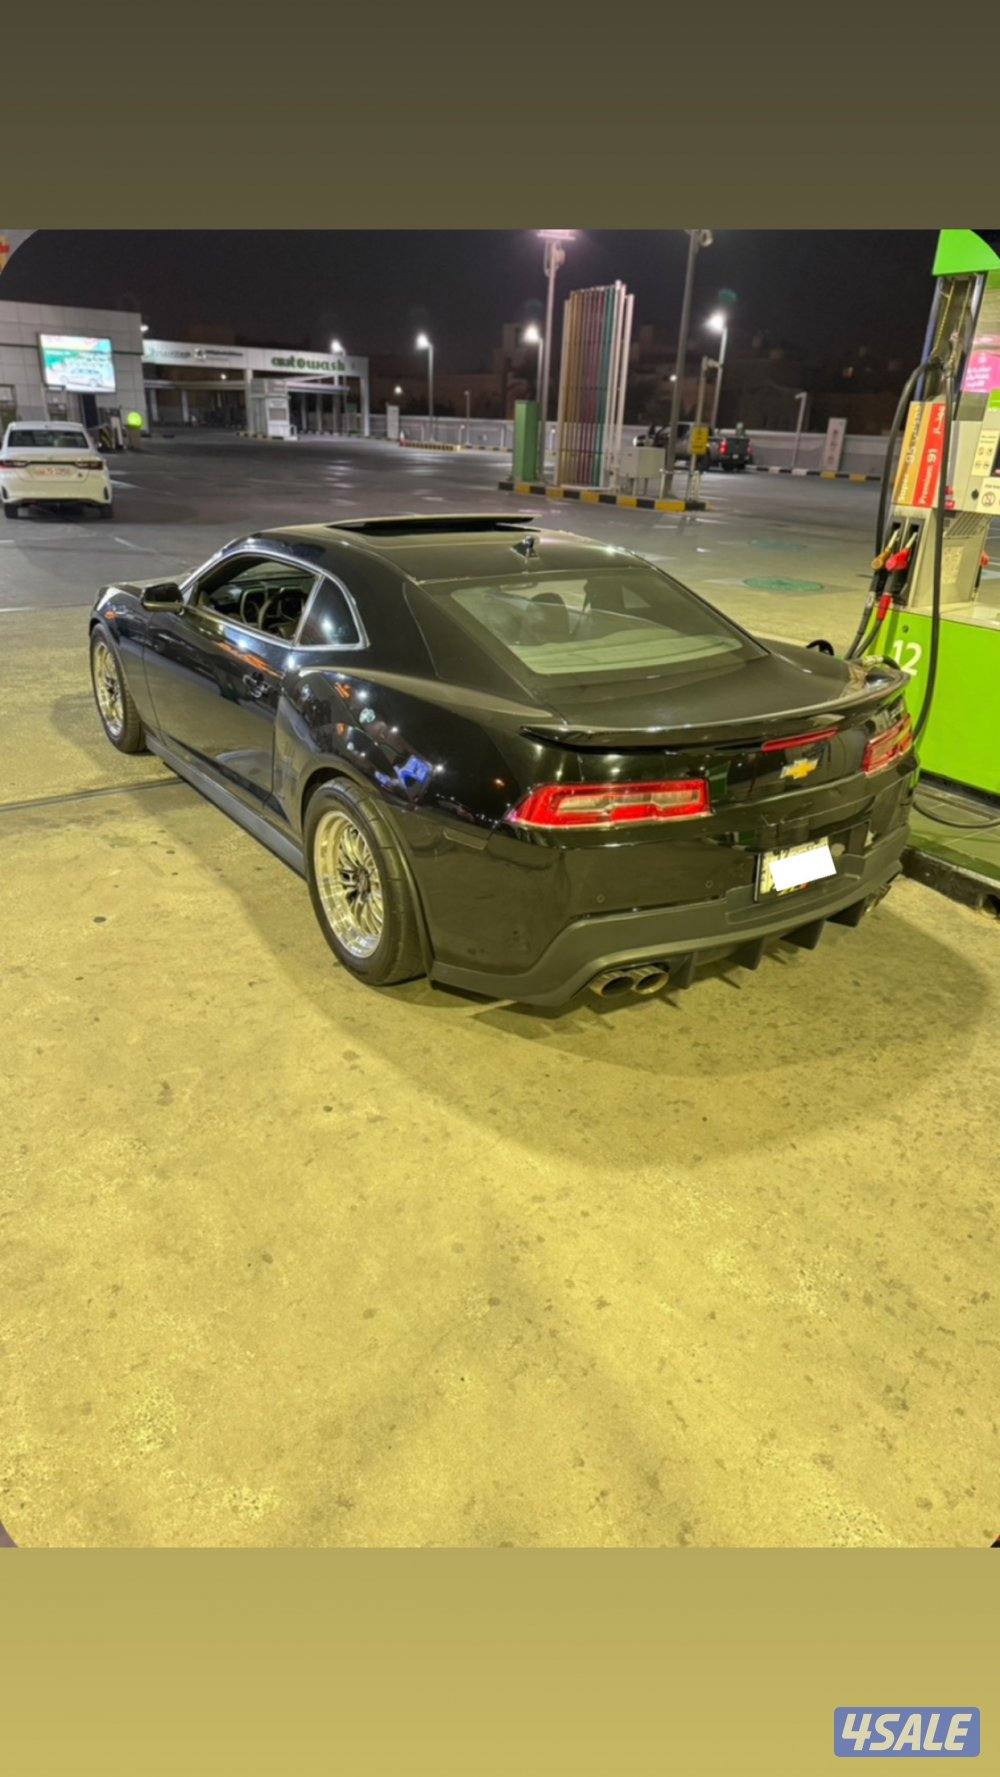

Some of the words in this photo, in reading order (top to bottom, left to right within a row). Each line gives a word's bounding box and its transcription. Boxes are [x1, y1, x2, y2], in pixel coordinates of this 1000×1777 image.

[271, 355, 345, 371] autowash
[927, 448, 937, 464] 91
[892, 640, 922, 676] 12
